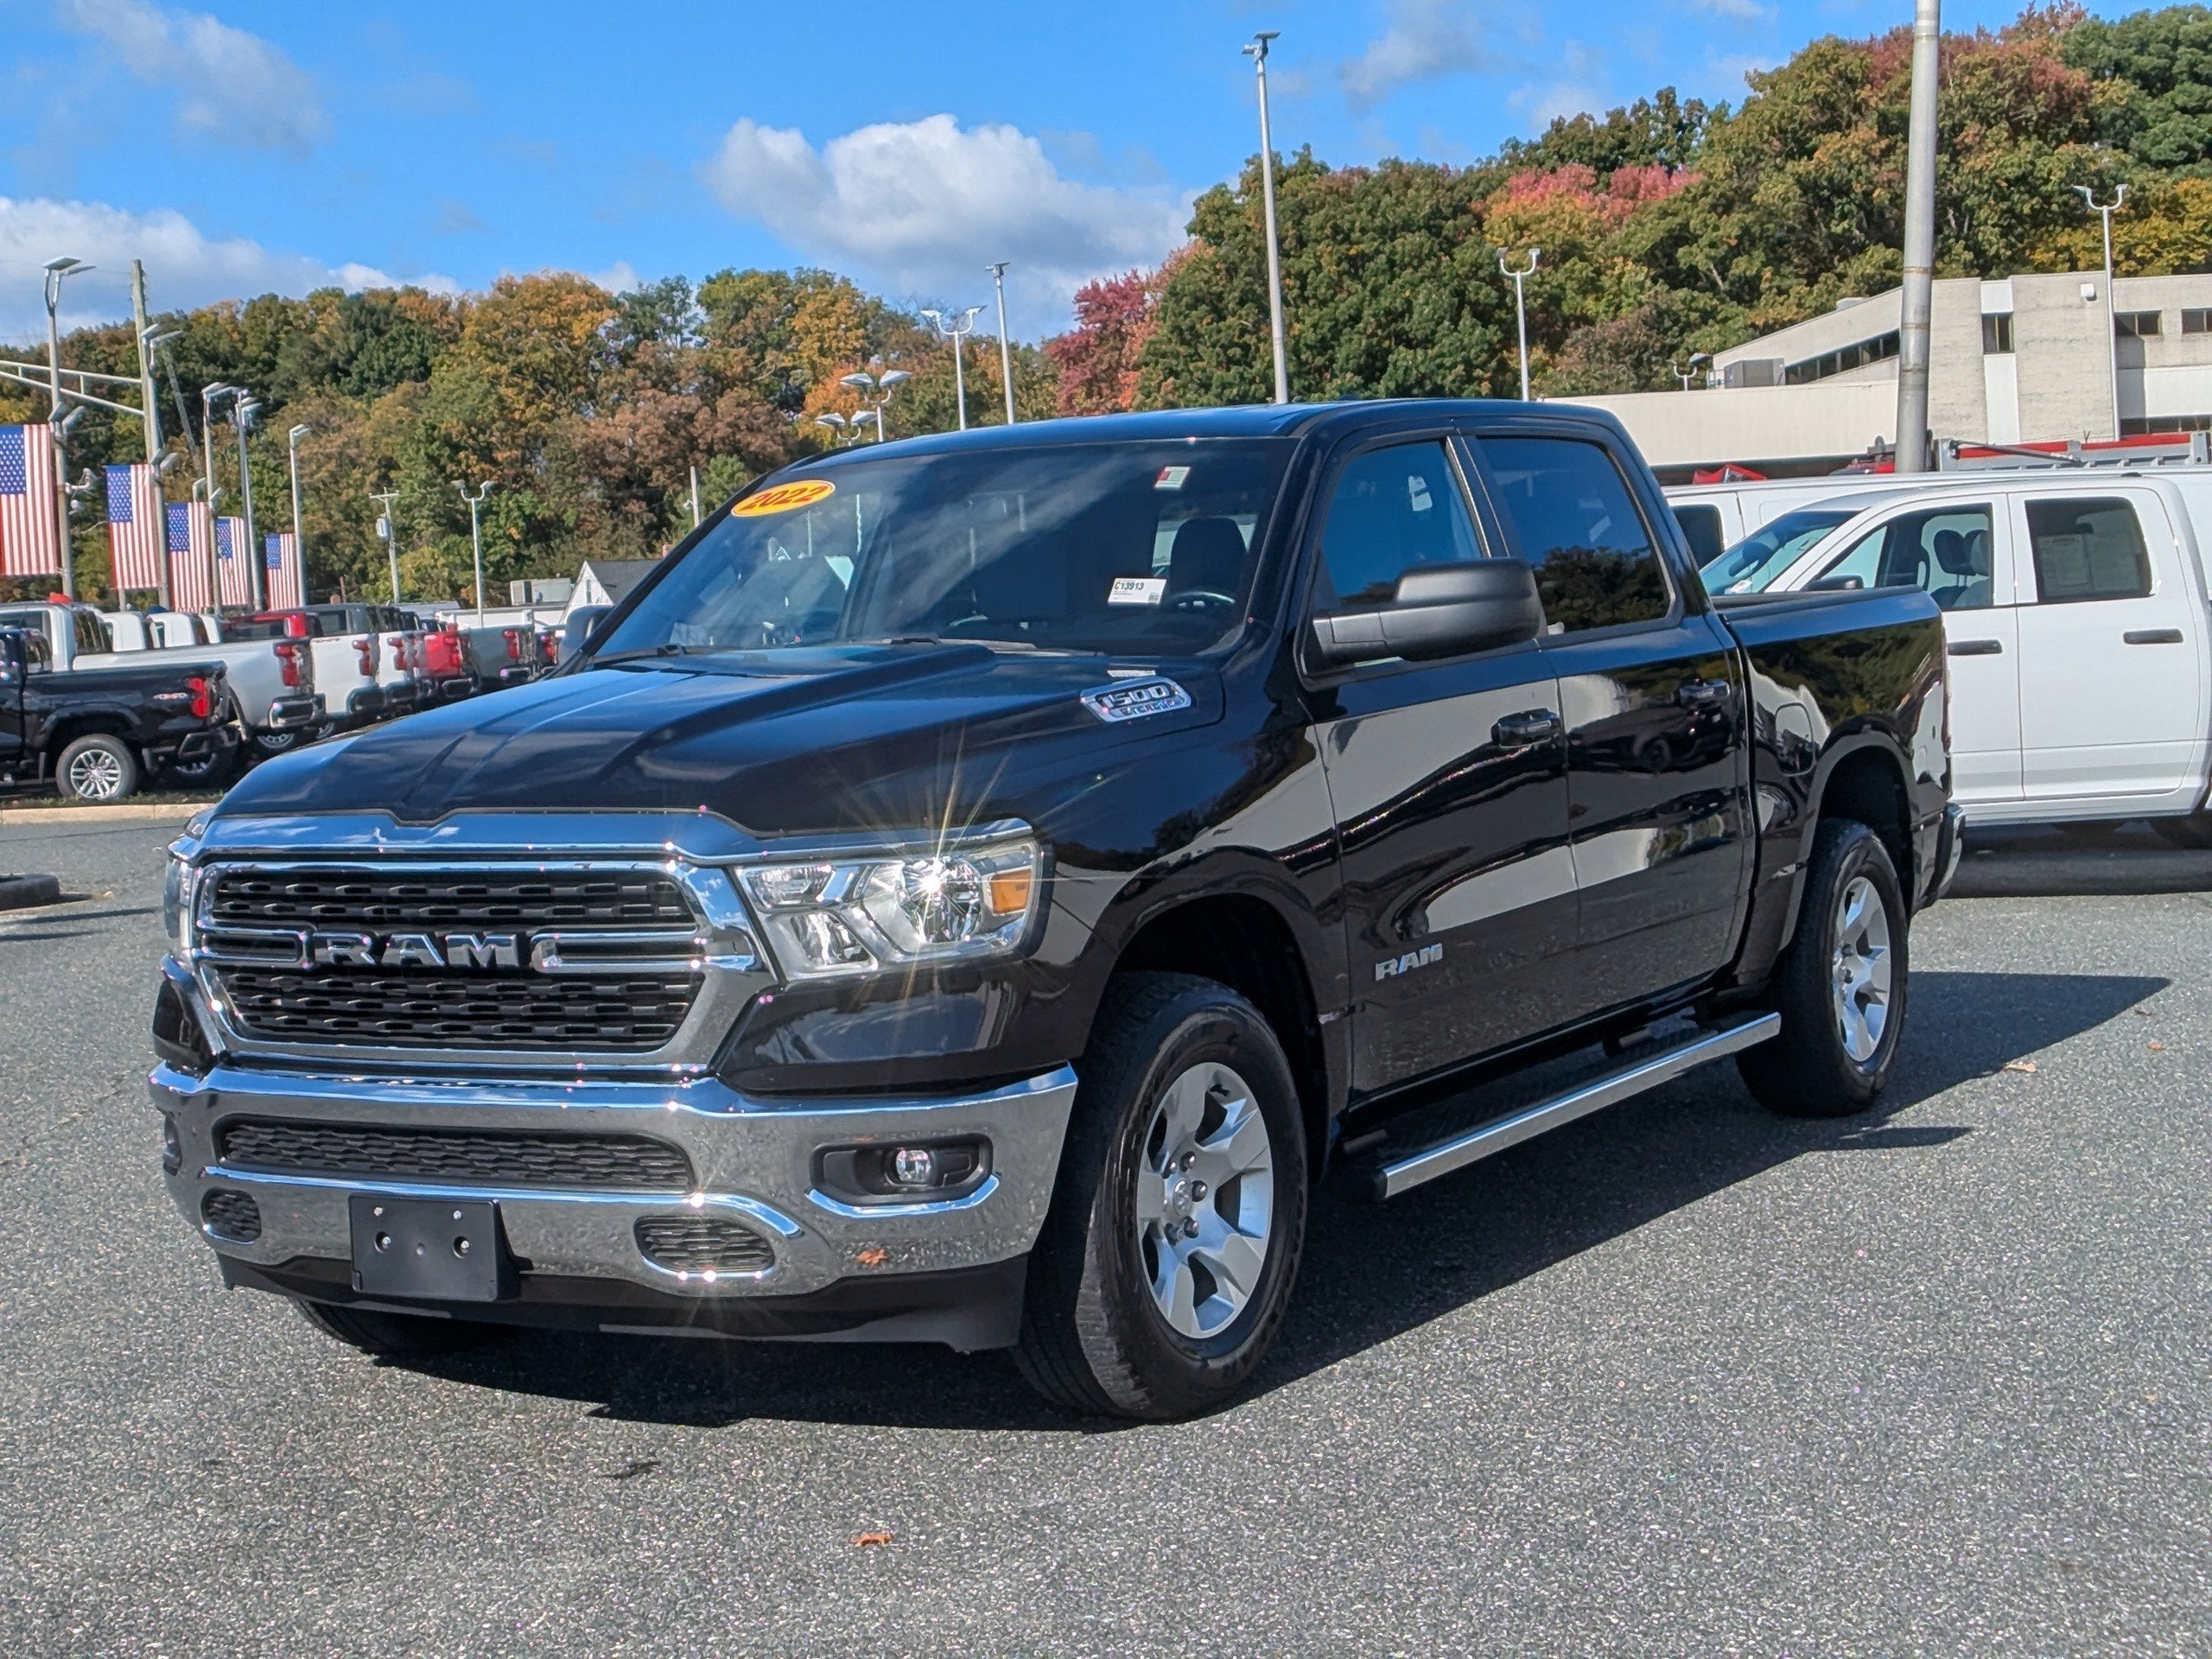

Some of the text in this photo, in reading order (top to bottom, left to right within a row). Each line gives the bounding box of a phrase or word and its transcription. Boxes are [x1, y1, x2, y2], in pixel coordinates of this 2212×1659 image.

[738, 485, 829, 512] 2022
[1100, 685, 1170, 709] 1500
[313, 931, 518, 968] RAM
[1375, 943, 1443, 981] RAM
